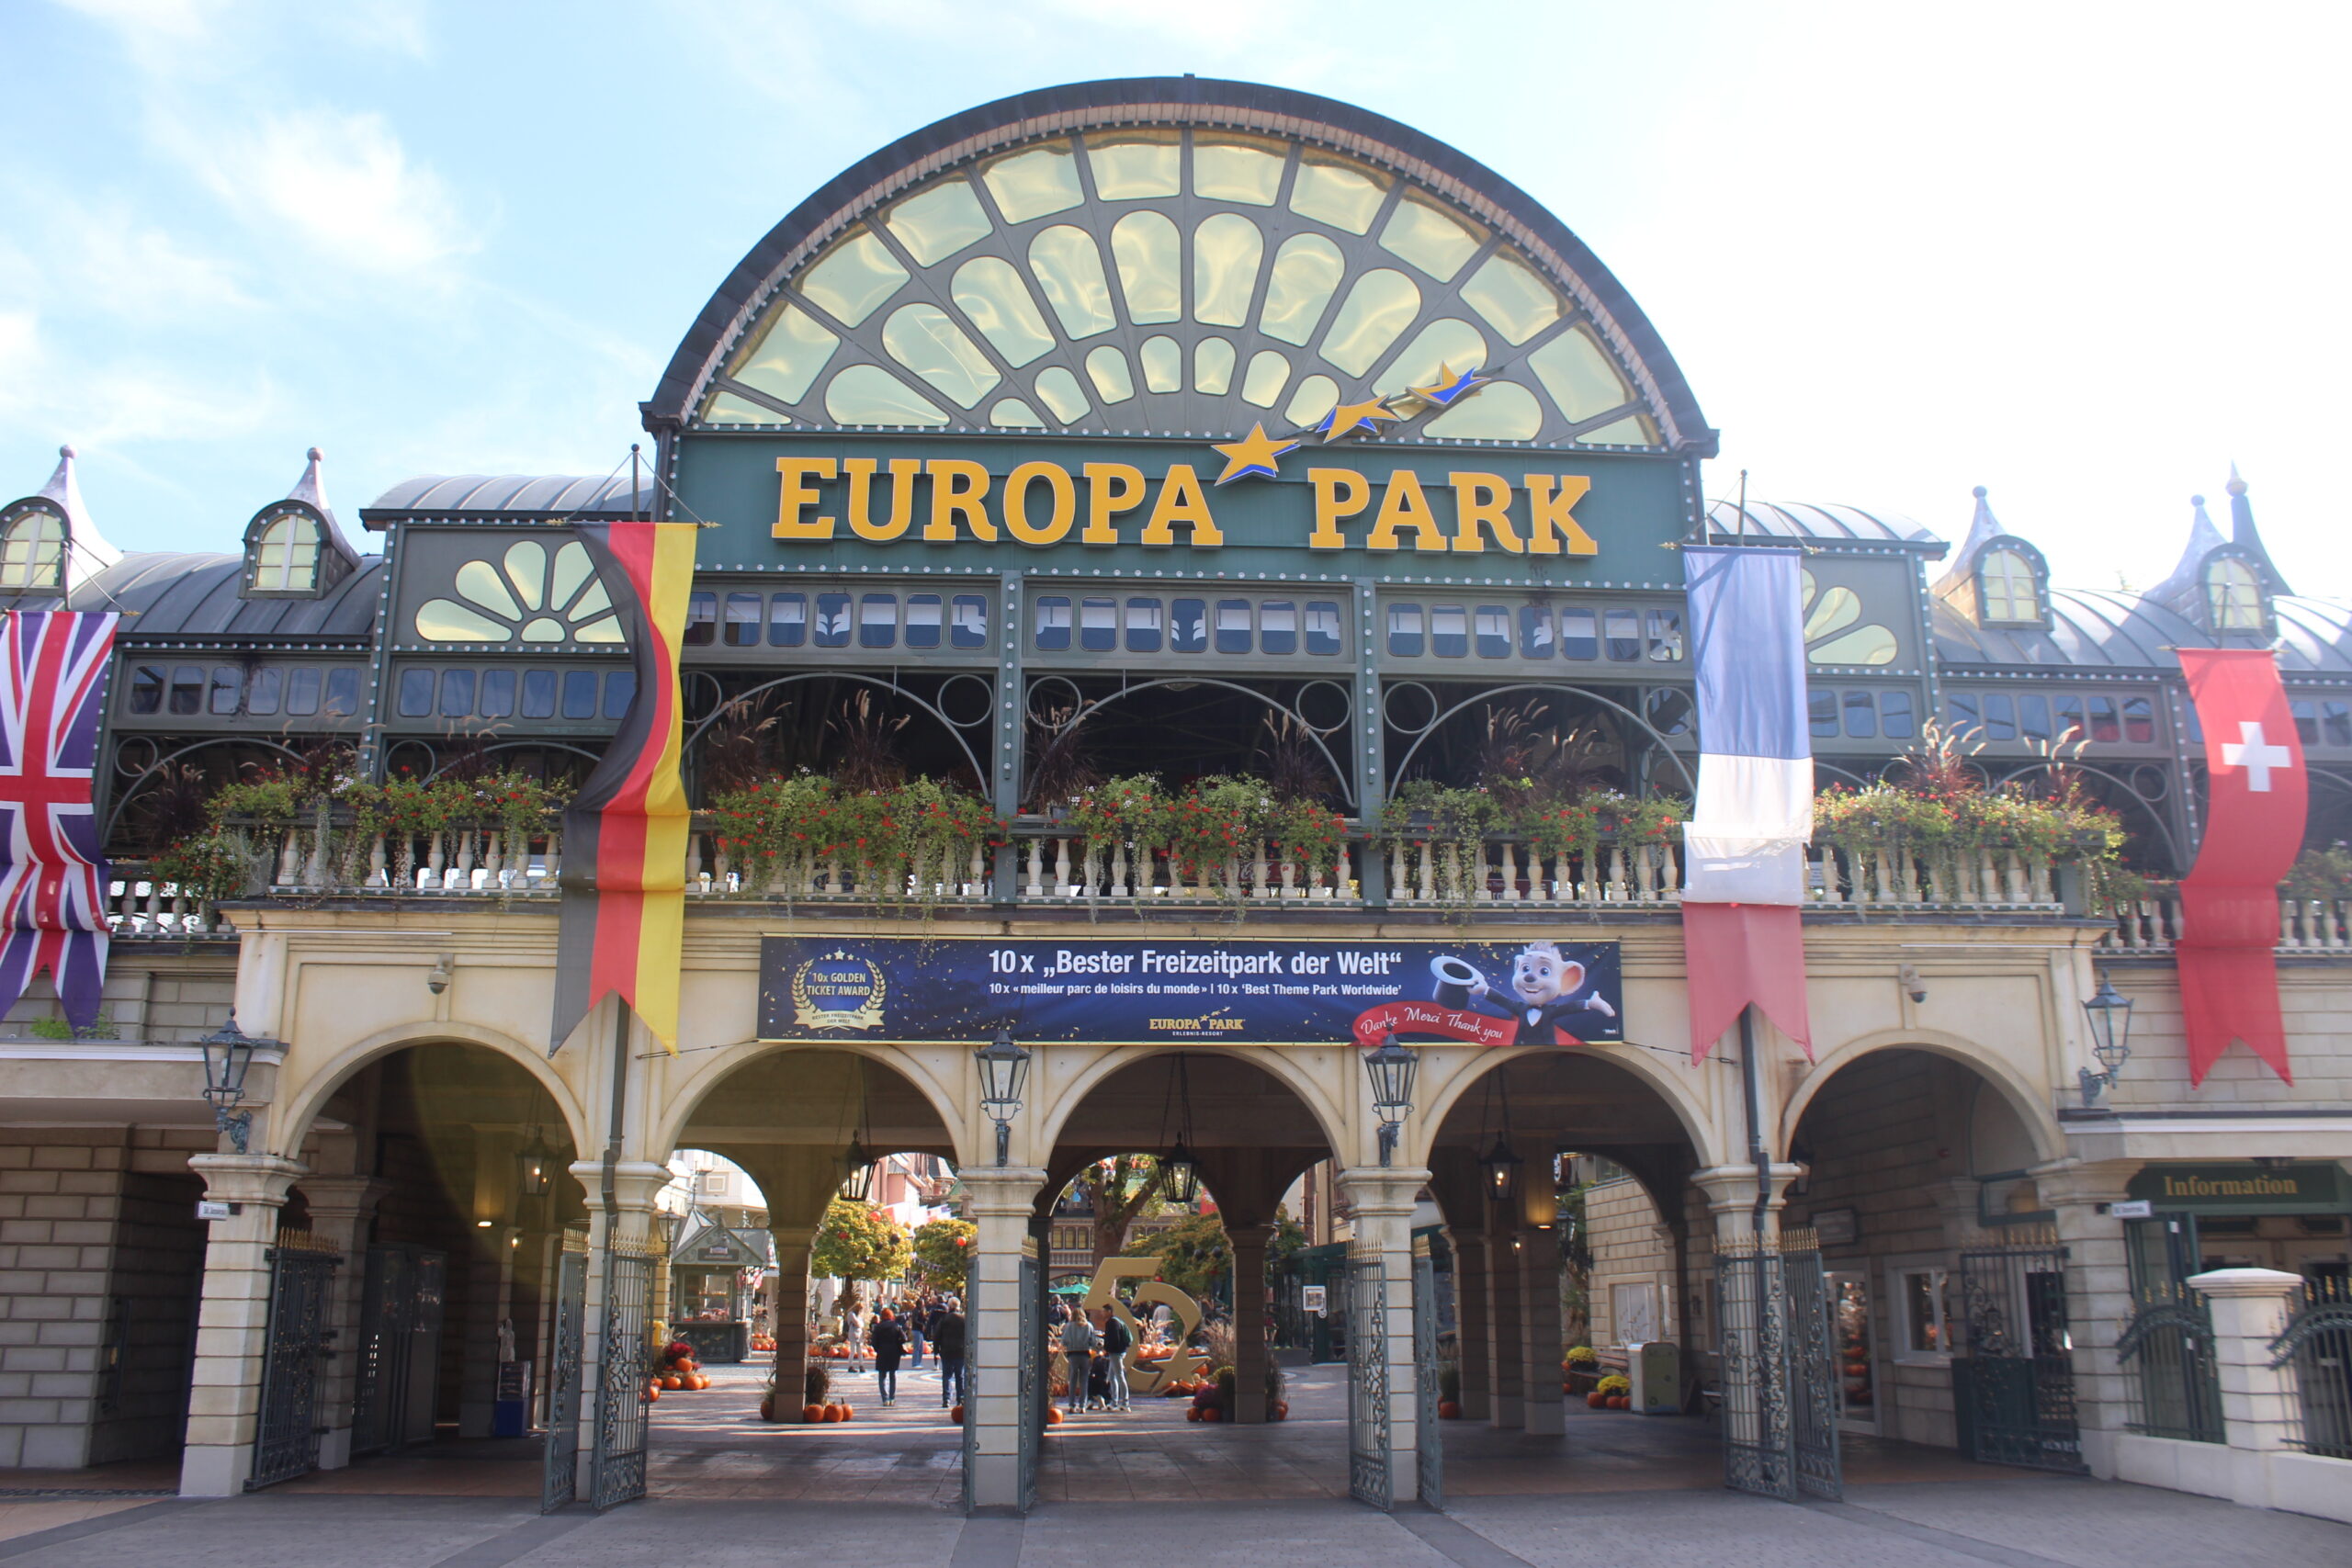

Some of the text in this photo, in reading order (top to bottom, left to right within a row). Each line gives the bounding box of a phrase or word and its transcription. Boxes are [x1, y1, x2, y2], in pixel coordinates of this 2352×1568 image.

[771, 457, 1598, 556] EUROPA PARK
[1141, 950, 1283, 979] Freizeitpark
[1291, 951, 1330, 975] der
[831, 973, 865, 982] GOLDEN
[807, 985, 871, 996] TICKET AWARD
[1067, 986, 1093, 996] parc
[1094, 983, 1108, 994] de
[1110, 983, 1144, 994] loisirs
[1147, 983, 1160, 994] du
[1272, 984, 1310, 995] Theme
[1312, 985, 1339, 995] Park
[1148, 1018, 1244, 1030] EUROPA PARK
[1404, 1007, 1442, 1024] Merci
[1447, 1013, 1481, 1035] Thank
[1479, 1027, 1504, 1043] you
[2164, 1174, 2299, 1196] Information
